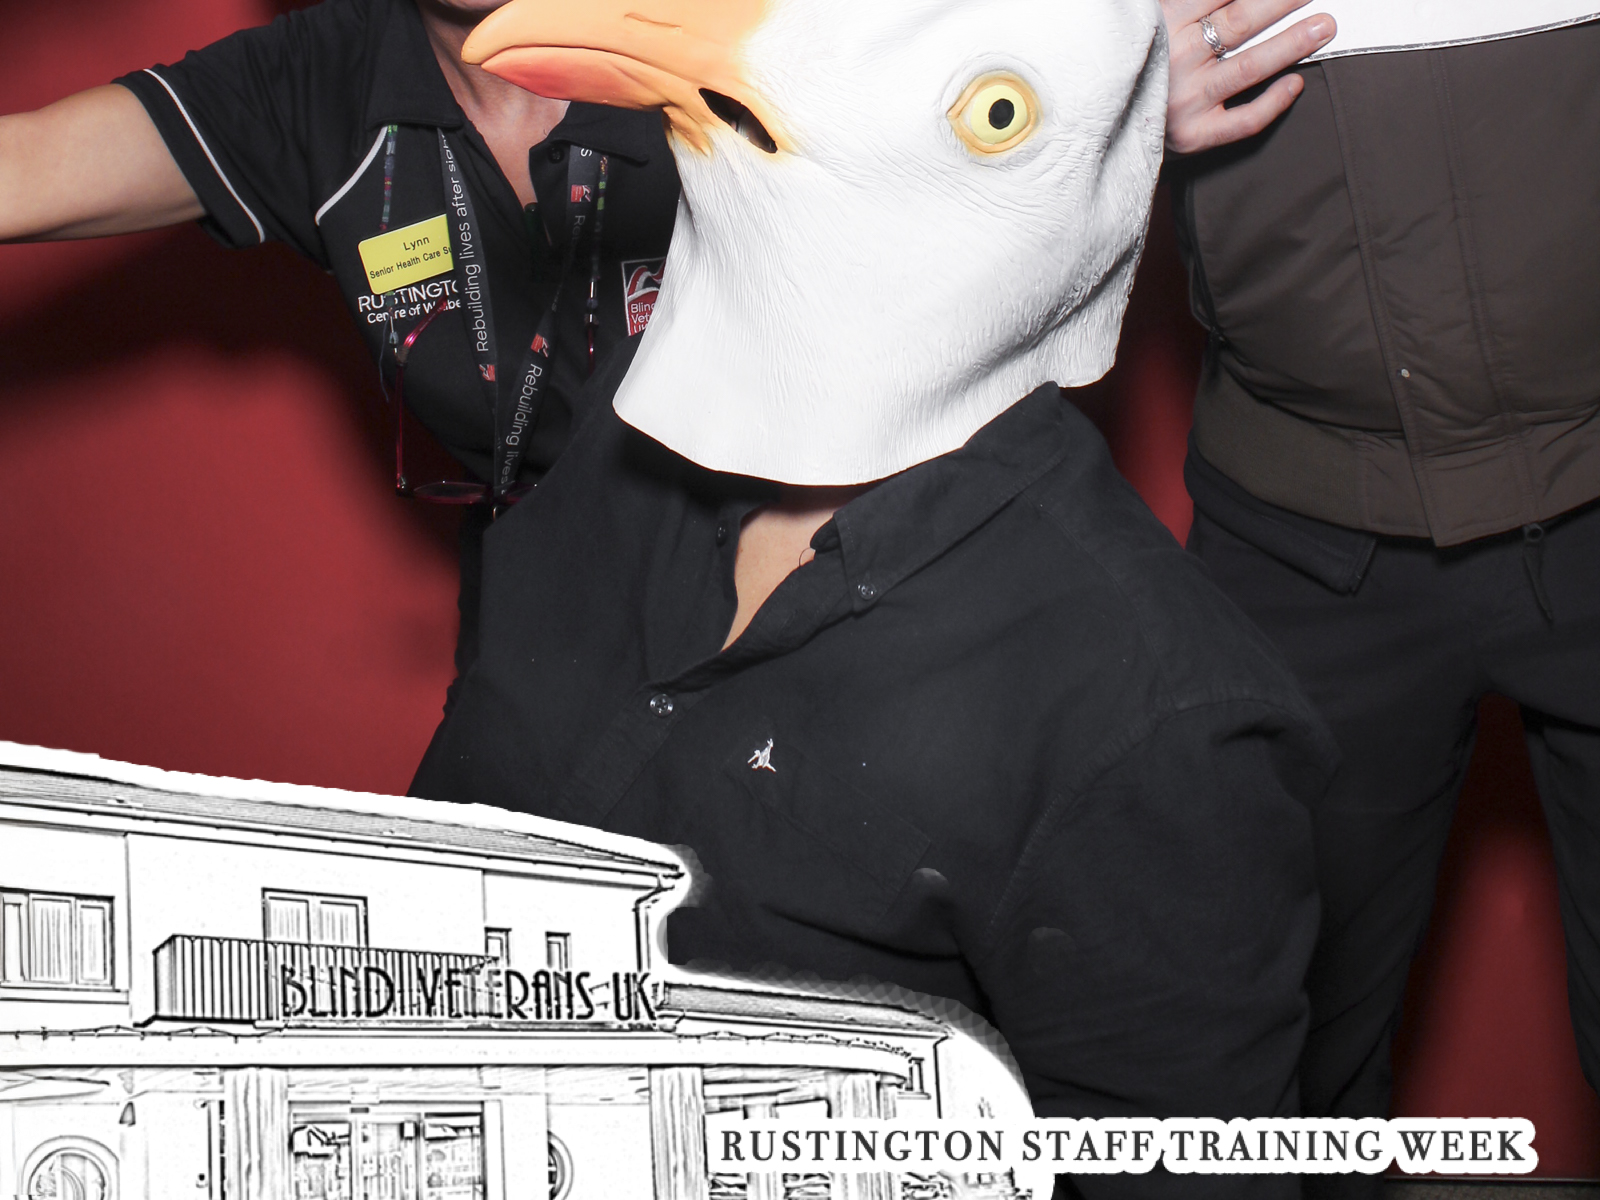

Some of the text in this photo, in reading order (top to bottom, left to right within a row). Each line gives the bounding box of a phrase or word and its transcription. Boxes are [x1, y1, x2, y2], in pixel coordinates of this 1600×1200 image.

[451, 177, 468, 217] after
[403, 236, 430, 251] Lynn
[459, 222, 475, 259] lives
[369, 265, 394, 279] Senior
[396, 256, 421, 271] Health
[422, 249, 441, 262] Care
[367, 307, 406, 324] Cenre
[408, 303, 421, 317] of
[465, 263, 489, 352] Rebuilding
[500, 363, 542, 484] Rebuilding lives
